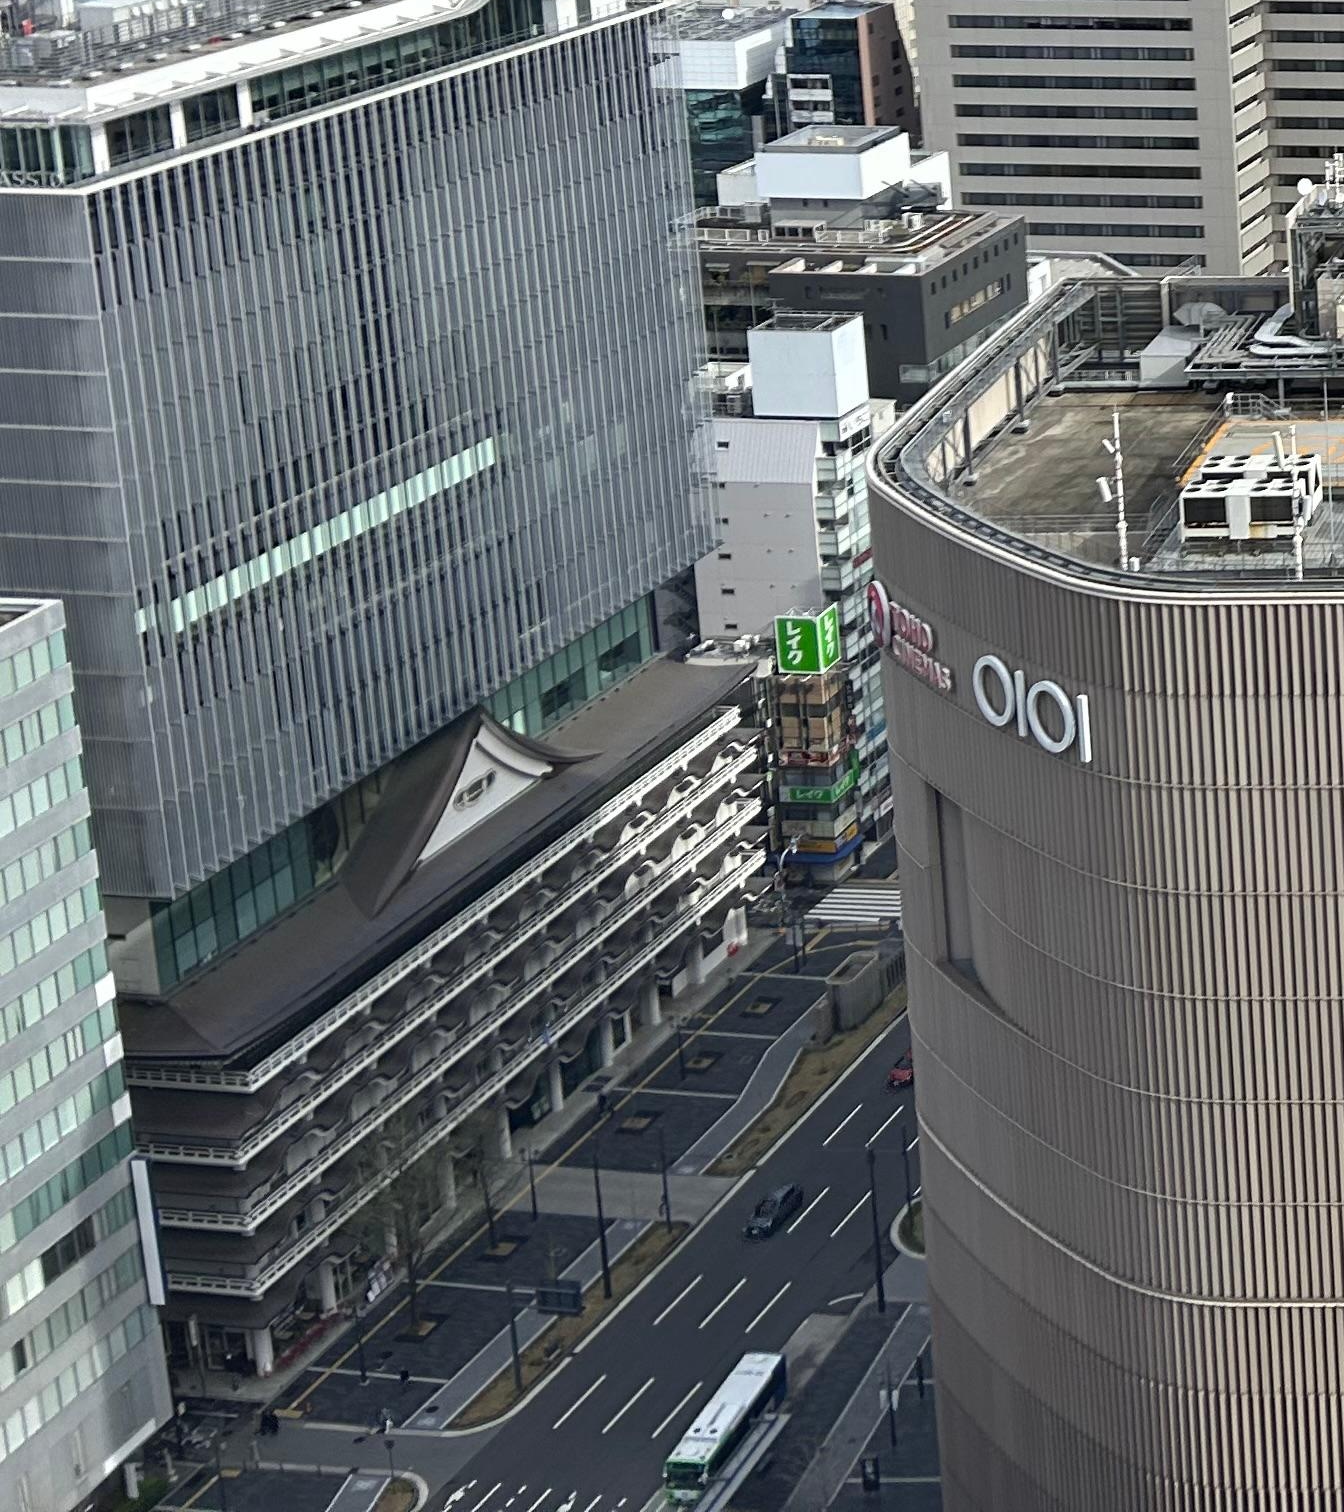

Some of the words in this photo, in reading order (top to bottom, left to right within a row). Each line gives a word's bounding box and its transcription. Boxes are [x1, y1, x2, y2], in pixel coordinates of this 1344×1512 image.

[786, 619, 804, 666] レイク
[824, 611, 835, 660] レイク
